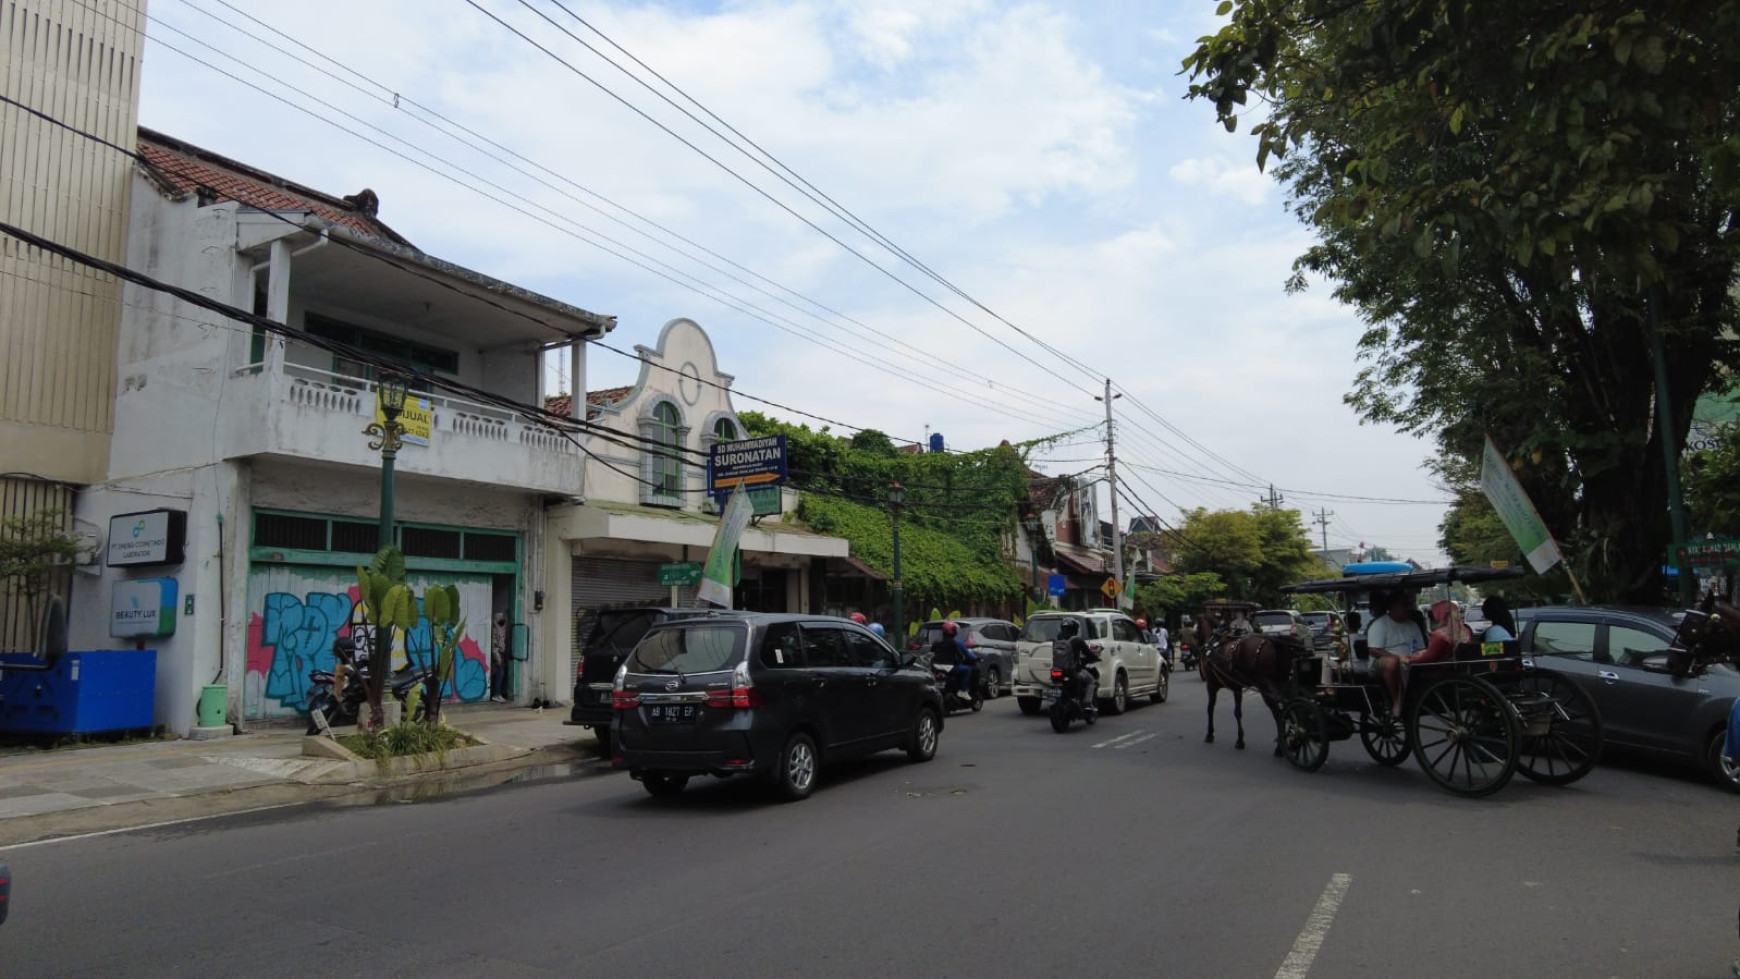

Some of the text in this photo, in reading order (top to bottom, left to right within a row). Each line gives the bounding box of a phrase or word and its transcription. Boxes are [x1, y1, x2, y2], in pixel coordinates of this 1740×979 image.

[717, 445, 726, 454] SD
[714, 448, 781, 466] SURONATAN
[115, 609, 156, 619] BEAUTY LUX
[651, 706, 661, 717] AB
[684, 706, 694, 717] EP
